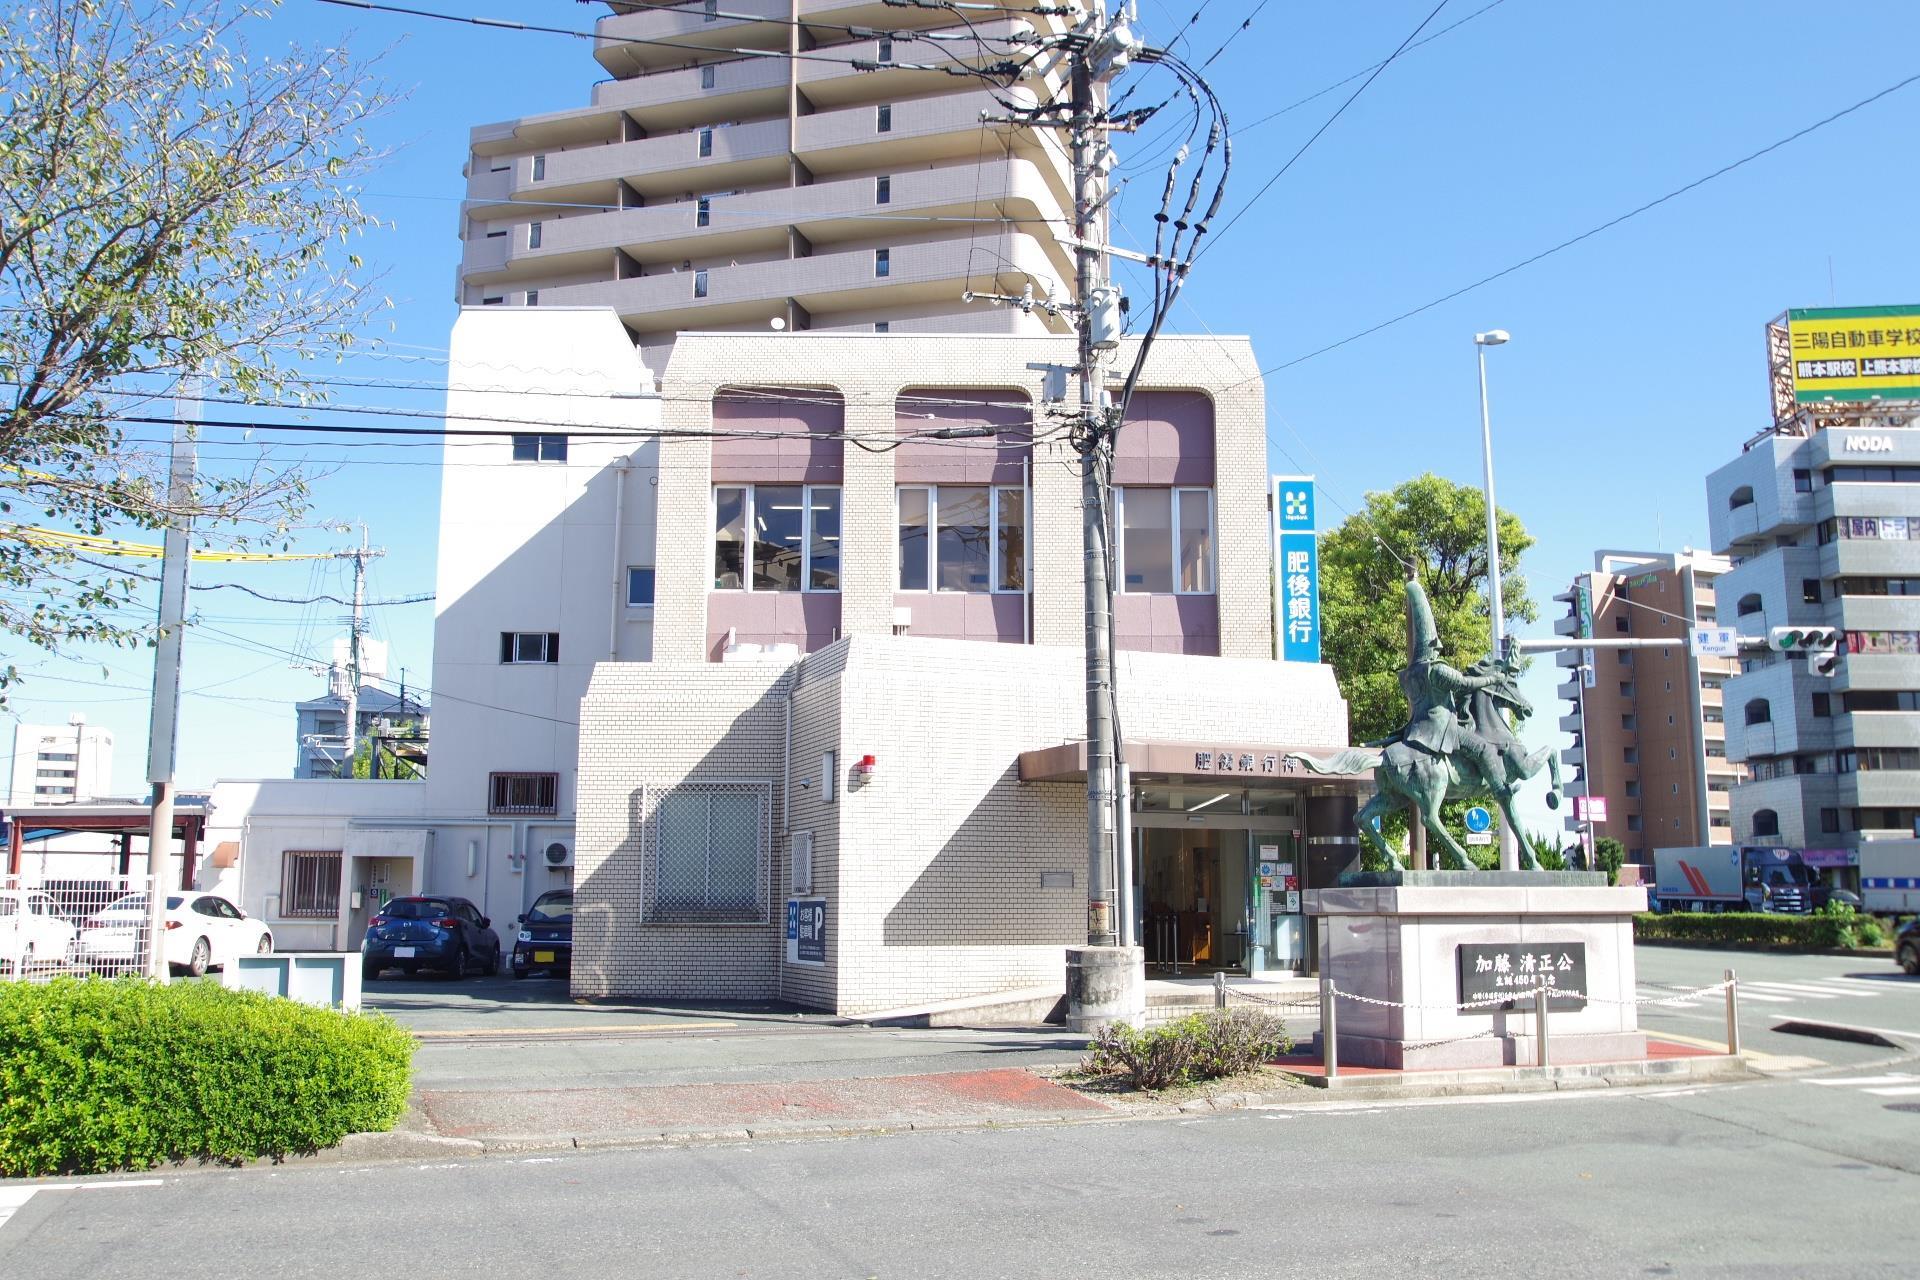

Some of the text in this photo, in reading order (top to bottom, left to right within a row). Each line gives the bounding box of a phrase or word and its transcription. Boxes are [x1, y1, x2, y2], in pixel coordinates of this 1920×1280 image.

[1793, 328, 1920, 349] 三陽自動車学校
[1846, 435, 1893, 451] NODA
[1287, 551, 1312, 643] 肥後銀行
[1195, 752, 1310, 774] 肥後銀行神
[814, 906, 823, 941] P
[1475, 952, 1574, 974] 加藤 清正公
